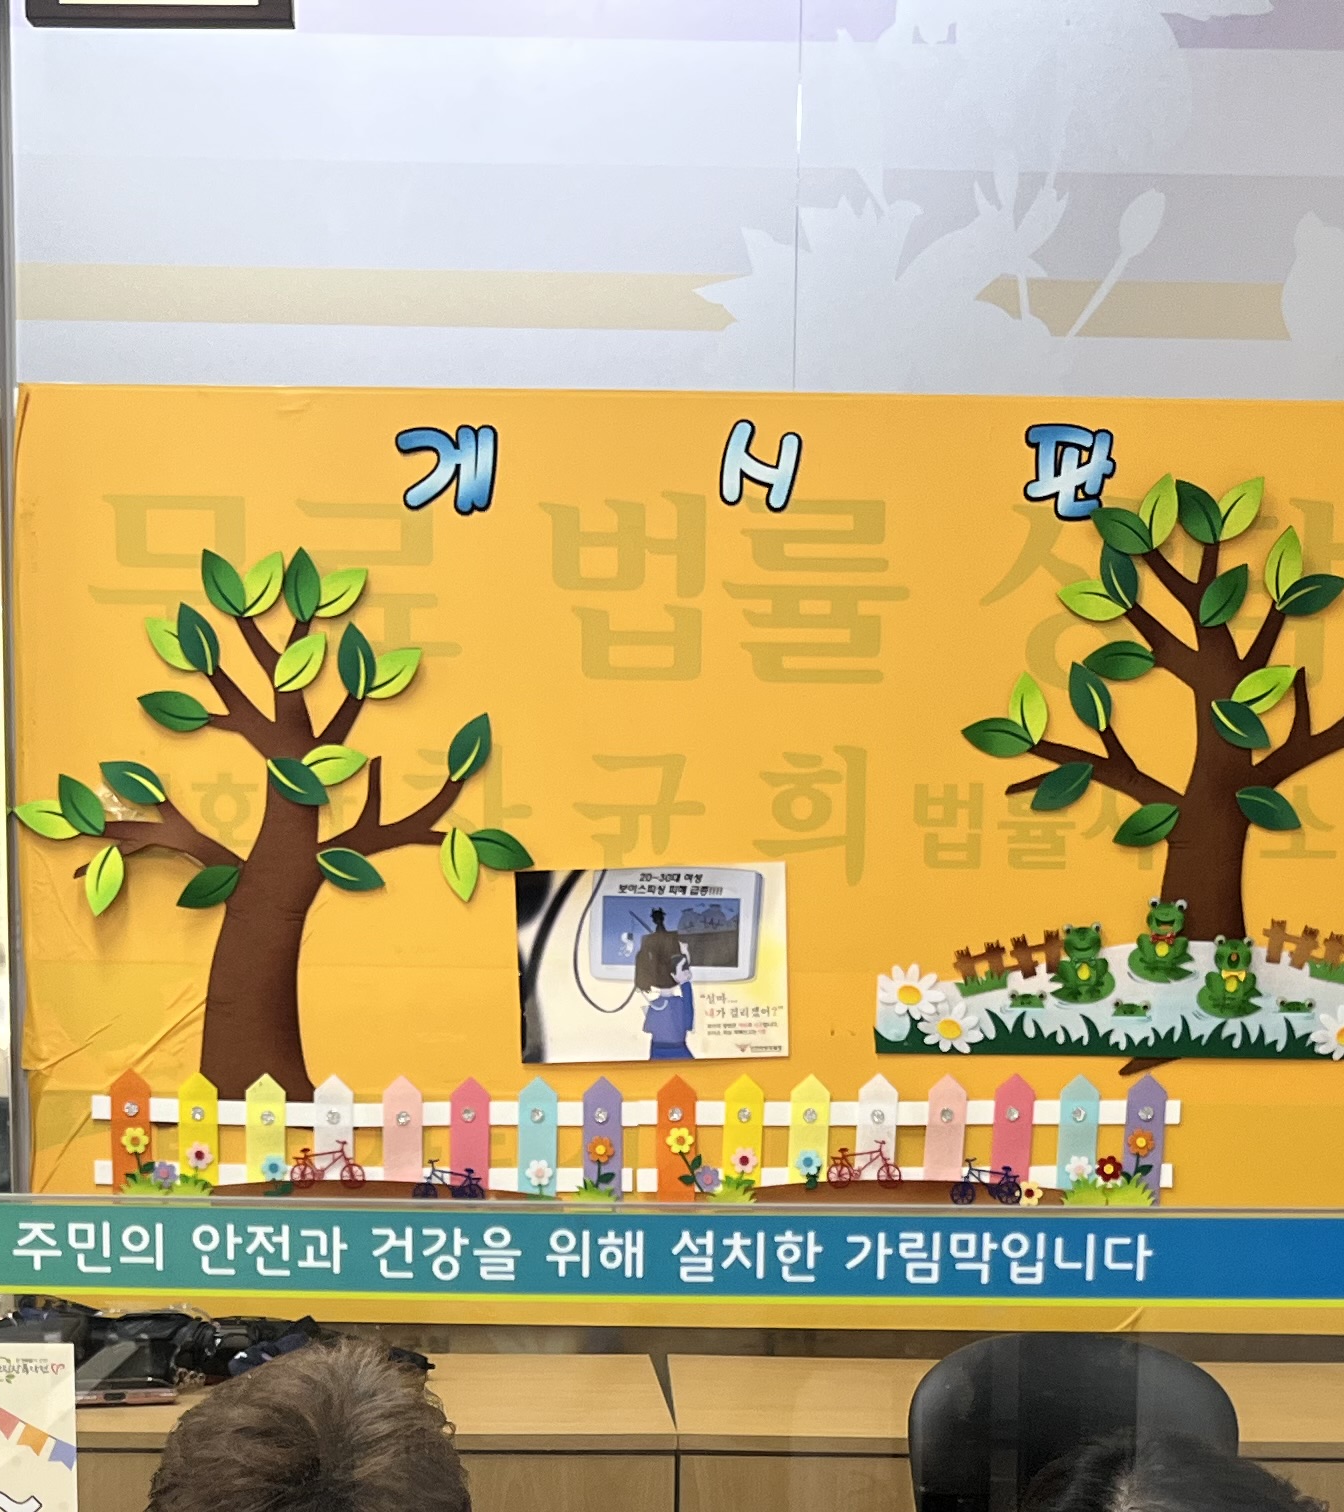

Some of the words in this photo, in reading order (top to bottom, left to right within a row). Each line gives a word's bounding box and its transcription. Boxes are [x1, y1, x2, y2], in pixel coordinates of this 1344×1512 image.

[548, 490, 908, 690] 법률
[684, 874, 703, 884] 여성
[12, 1221, 165, 1275] 주민의
[190, 1224, 347, 1276] 안전과
[371, 1227, 522, 1281] 건강을
[547, 1229, 644, 1280] 위해
[671, 1231, 822, 1284] 설치한
[844, 1231, 1152, 1285] 가림막입니다
